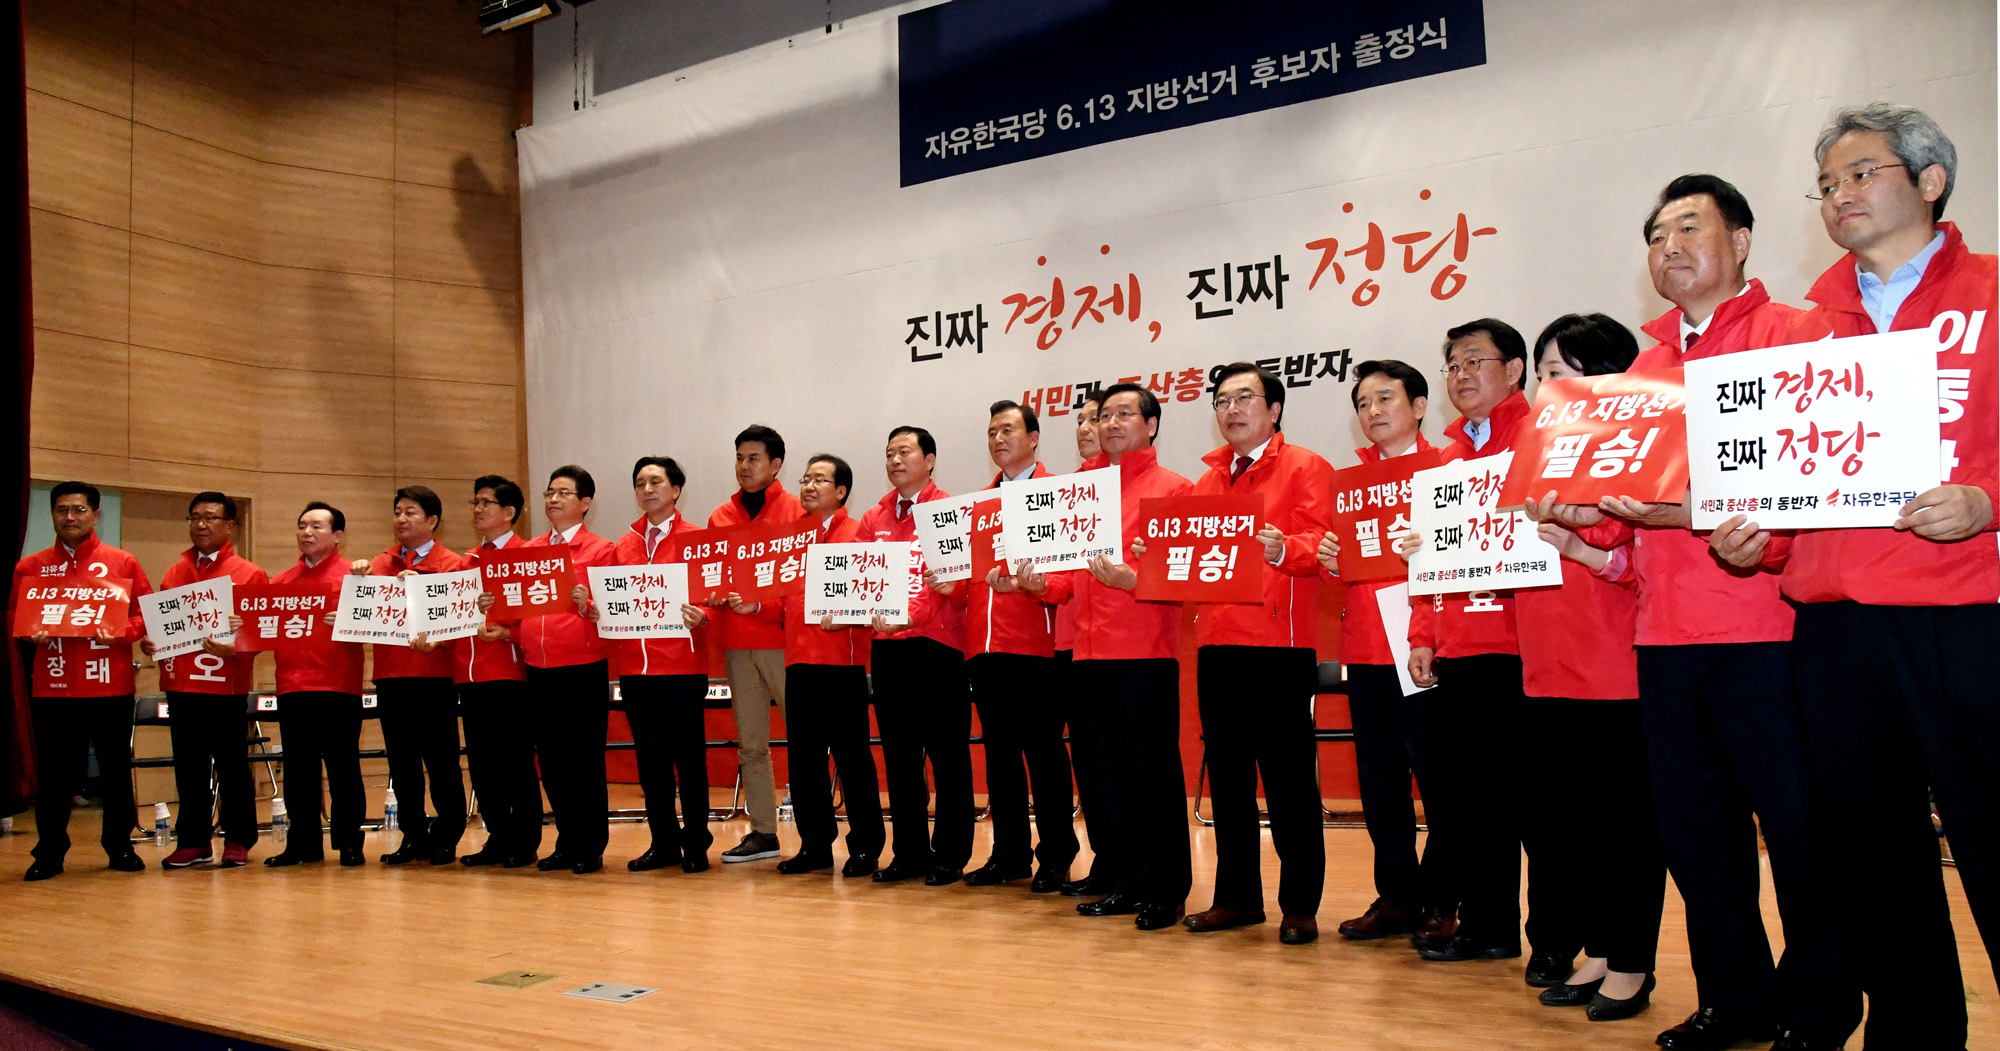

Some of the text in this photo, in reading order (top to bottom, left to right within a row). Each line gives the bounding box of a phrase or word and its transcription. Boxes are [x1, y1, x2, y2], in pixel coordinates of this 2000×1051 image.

[925, 18, 1449, 160] 자유한국당 6.13 지방선거 후보자 출정식
[904, 212, 1498, 362] 진짜 경제, 진짜 정당
[1716, 360, 1874, 414] 진짜 경제,
[1535, 400, 1587, 428] 6.13
[1717, 421, 1880, 476] 진짜 정당
[1025, 483, 1099, 512] 진짜 경제,
[1336, 488, 1363, 514] 6.13
[1433, 481, 1464, 509] 진짜
[1700, 491, 1917, 513] 서민과 중산층의 동반자 자유한국당
[932, 509, 958, 529] 진짜
[1027, 513, 1101, 543] 진짜 정당
[1147, 515, 1255, 538] 6.13 지방선거
[1434, 511, 1523, 551] 진짜 정당
[683, 543, 711, 560] 6.13
[737, 529, 817, 560] 6.13 지방선거
[937, 536, 964, 555] 진짜
[486, 558, 565, 578] 6.13 지방선거
[824, 550, 888, 573] 진짜 경제,
[948, 563, 970, 573] 중산층의
[1034, 555, 1057, 565] 중산층의
[1059, 552, 1077, 561] 동반자
[604, 572, 667, 593] 진짜 경제,
[1416, 560, 1547, 582] 서민과 중산층의 동반자 자유한국당
[26, 587, 122, 600] 6.13 지방선거
[355, 585, 376, 598] 진짜
[425, 577, 478, 598] 진짜 경제,
[823, 577, 890, 602] 진짜 정당
[158, 589, 218, 614] 진짜 경제,
[240, 596, 325, 611] 6.13 지방선거
[427, 598, 478, 620] 진짜 정당
[607, 597, 670, 619] 진짜 정당
[163, 609, 223, 636] 진짜 정당
[352, 604, 407, 627] 진짜 정당
